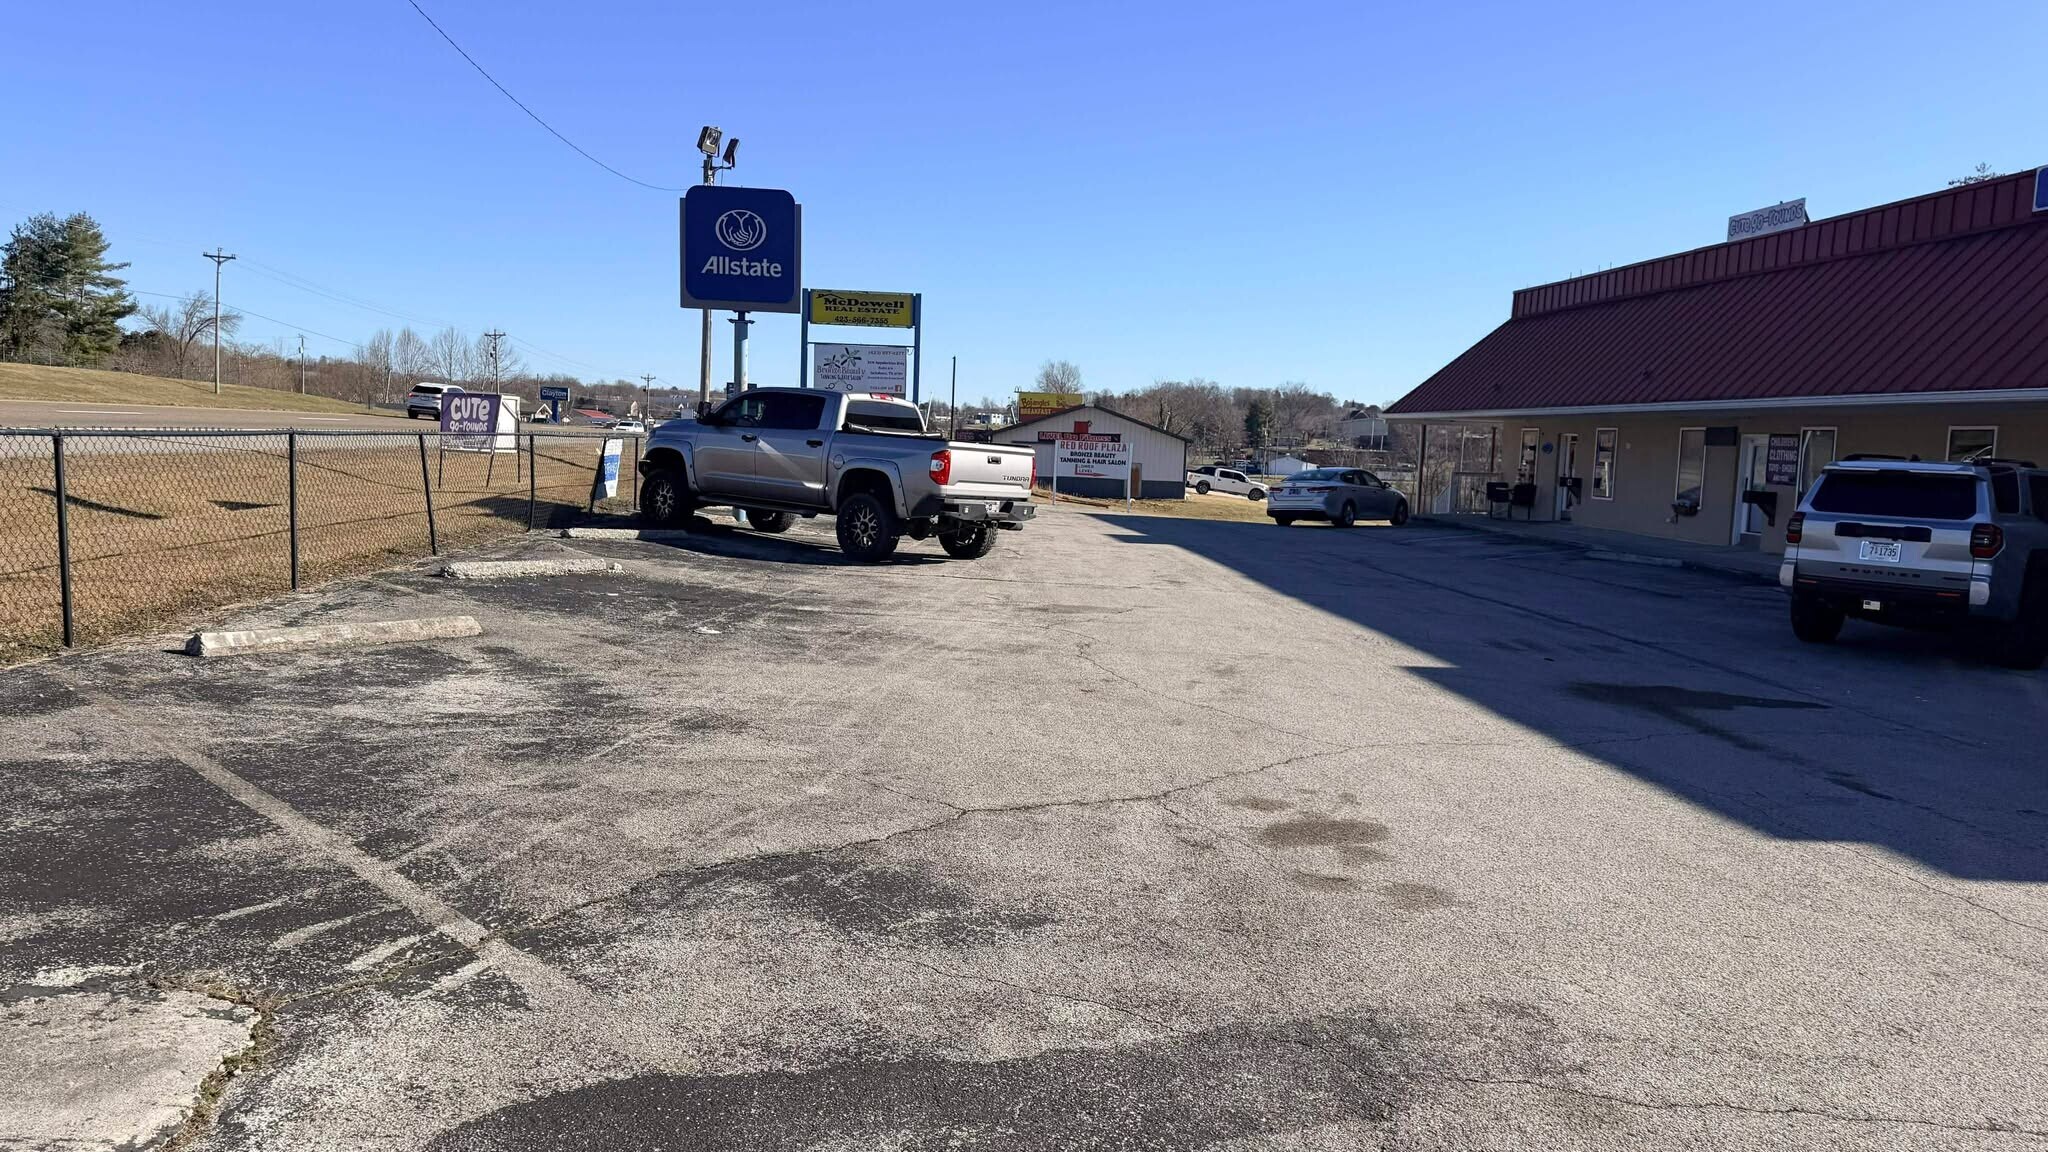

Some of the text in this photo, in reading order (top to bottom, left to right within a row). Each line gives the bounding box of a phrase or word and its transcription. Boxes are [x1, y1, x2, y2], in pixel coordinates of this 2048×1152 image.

[701, 255, 782, 278] Allstate
[824, 298, 904, 309] McDowell
[541, 388, 567, 398] Clayton
[1060, 440, 1127, 452] RED ROOF PLAZA
[1769, 449, 1798, 462] CLOTHING
[1002, 475, 1030, 483] TUNDRA
